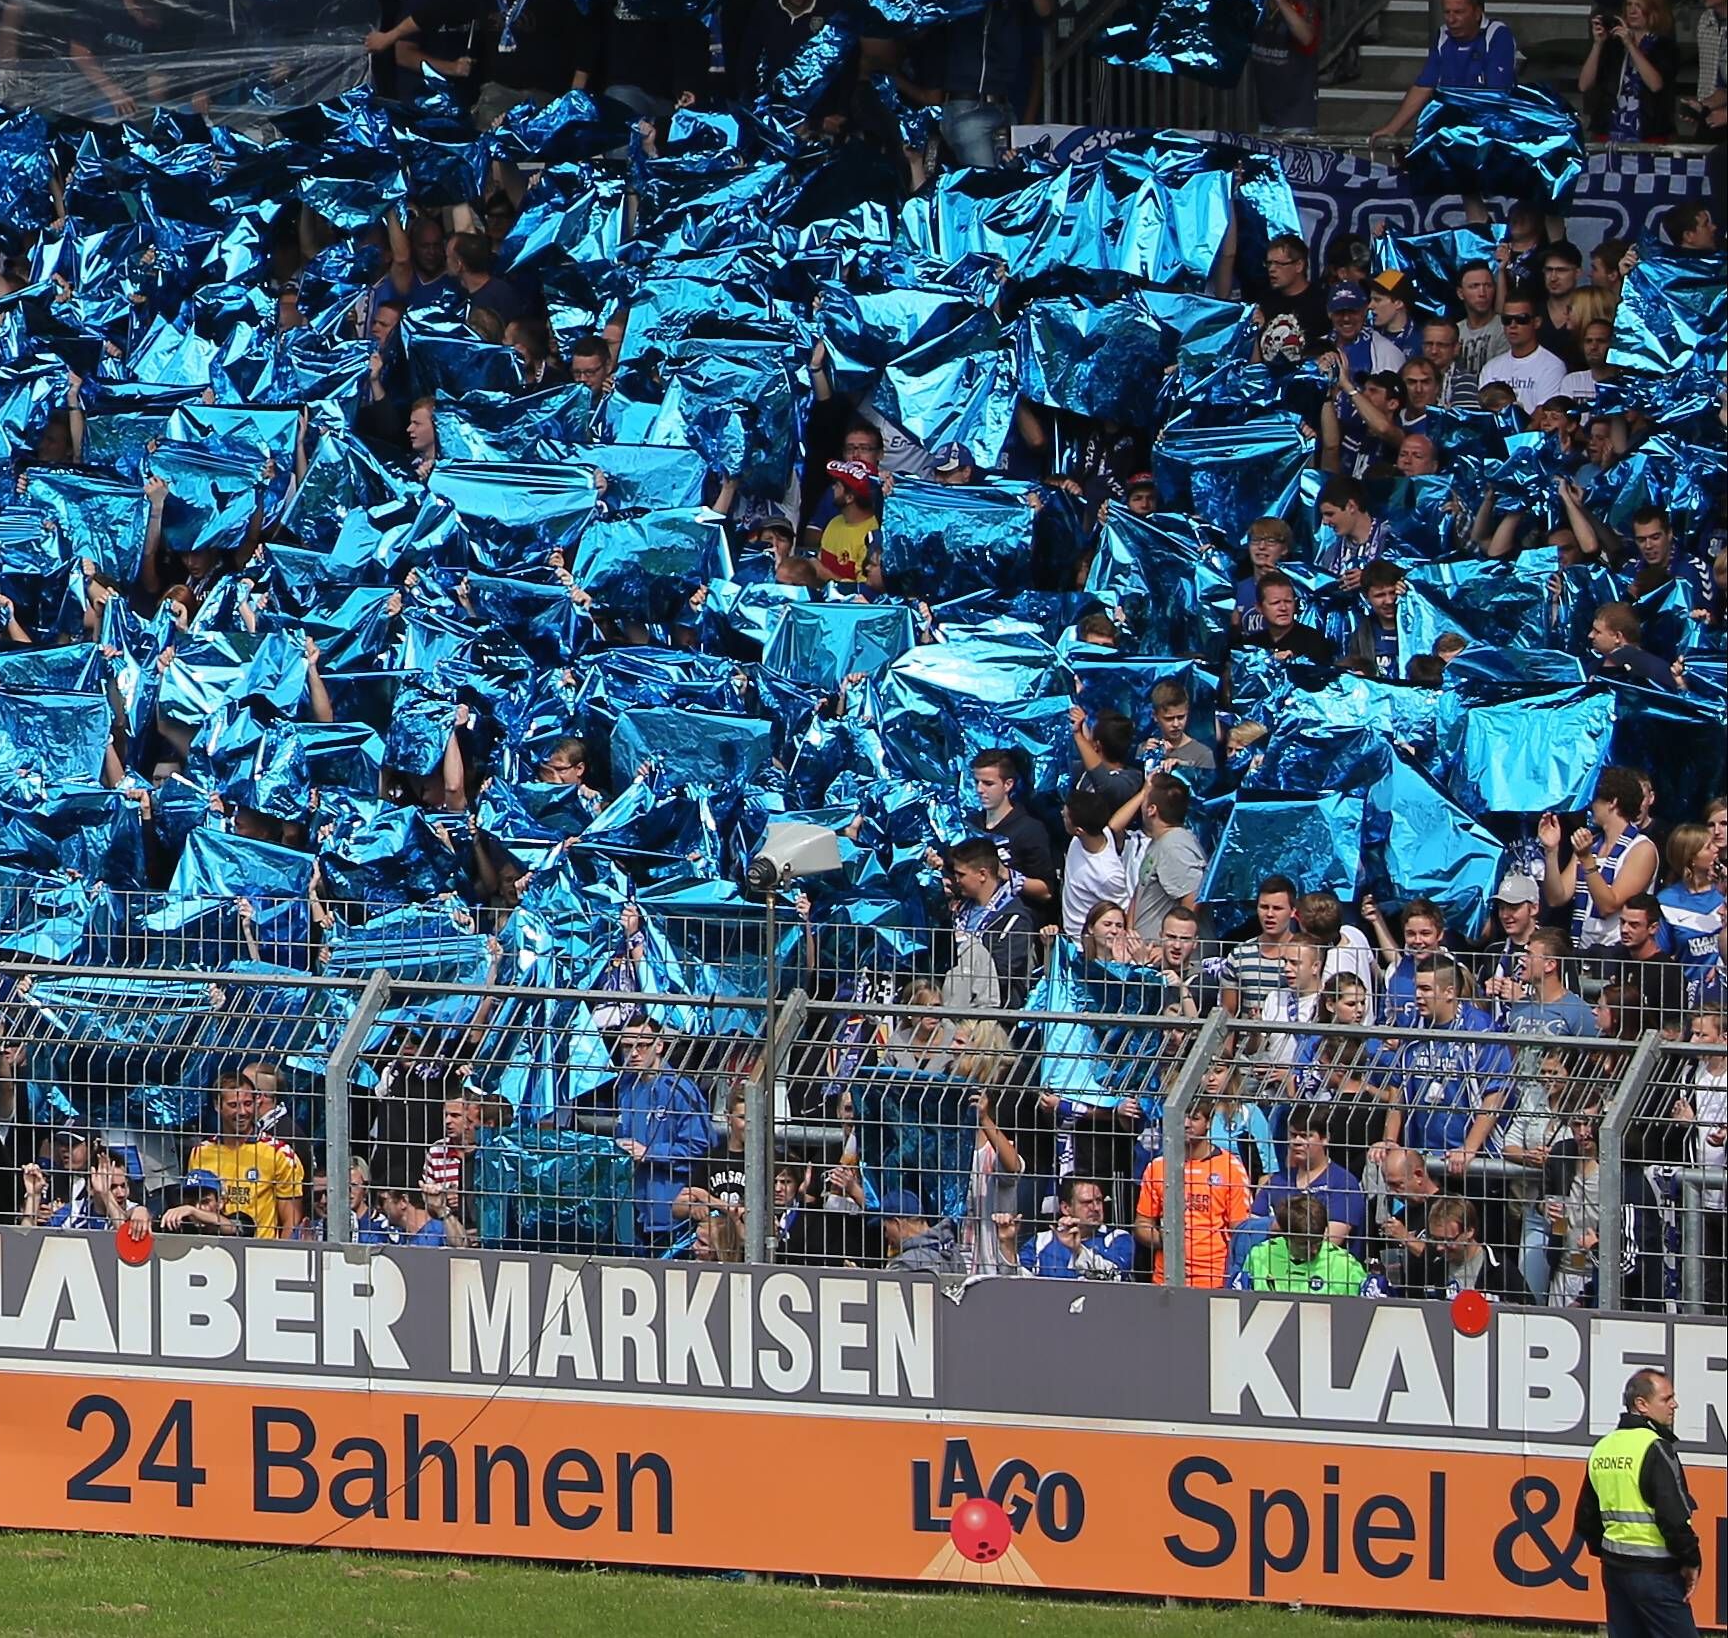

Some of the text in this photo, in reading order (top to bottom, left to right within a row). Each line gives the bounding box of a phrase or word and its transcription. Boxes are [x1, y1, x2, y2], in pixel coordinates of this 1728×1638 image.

[450, 1258, 935, 1399] MARKISEN
[66, 1393, 207, 1508] 24
[252, 1405, 674, 1536] Bahnen
[911, 1436, 1085, 1543] LAGO
[1164, 1454, 1446, 1597] Spiel
[1493, 1475, 1590, 1590] &
